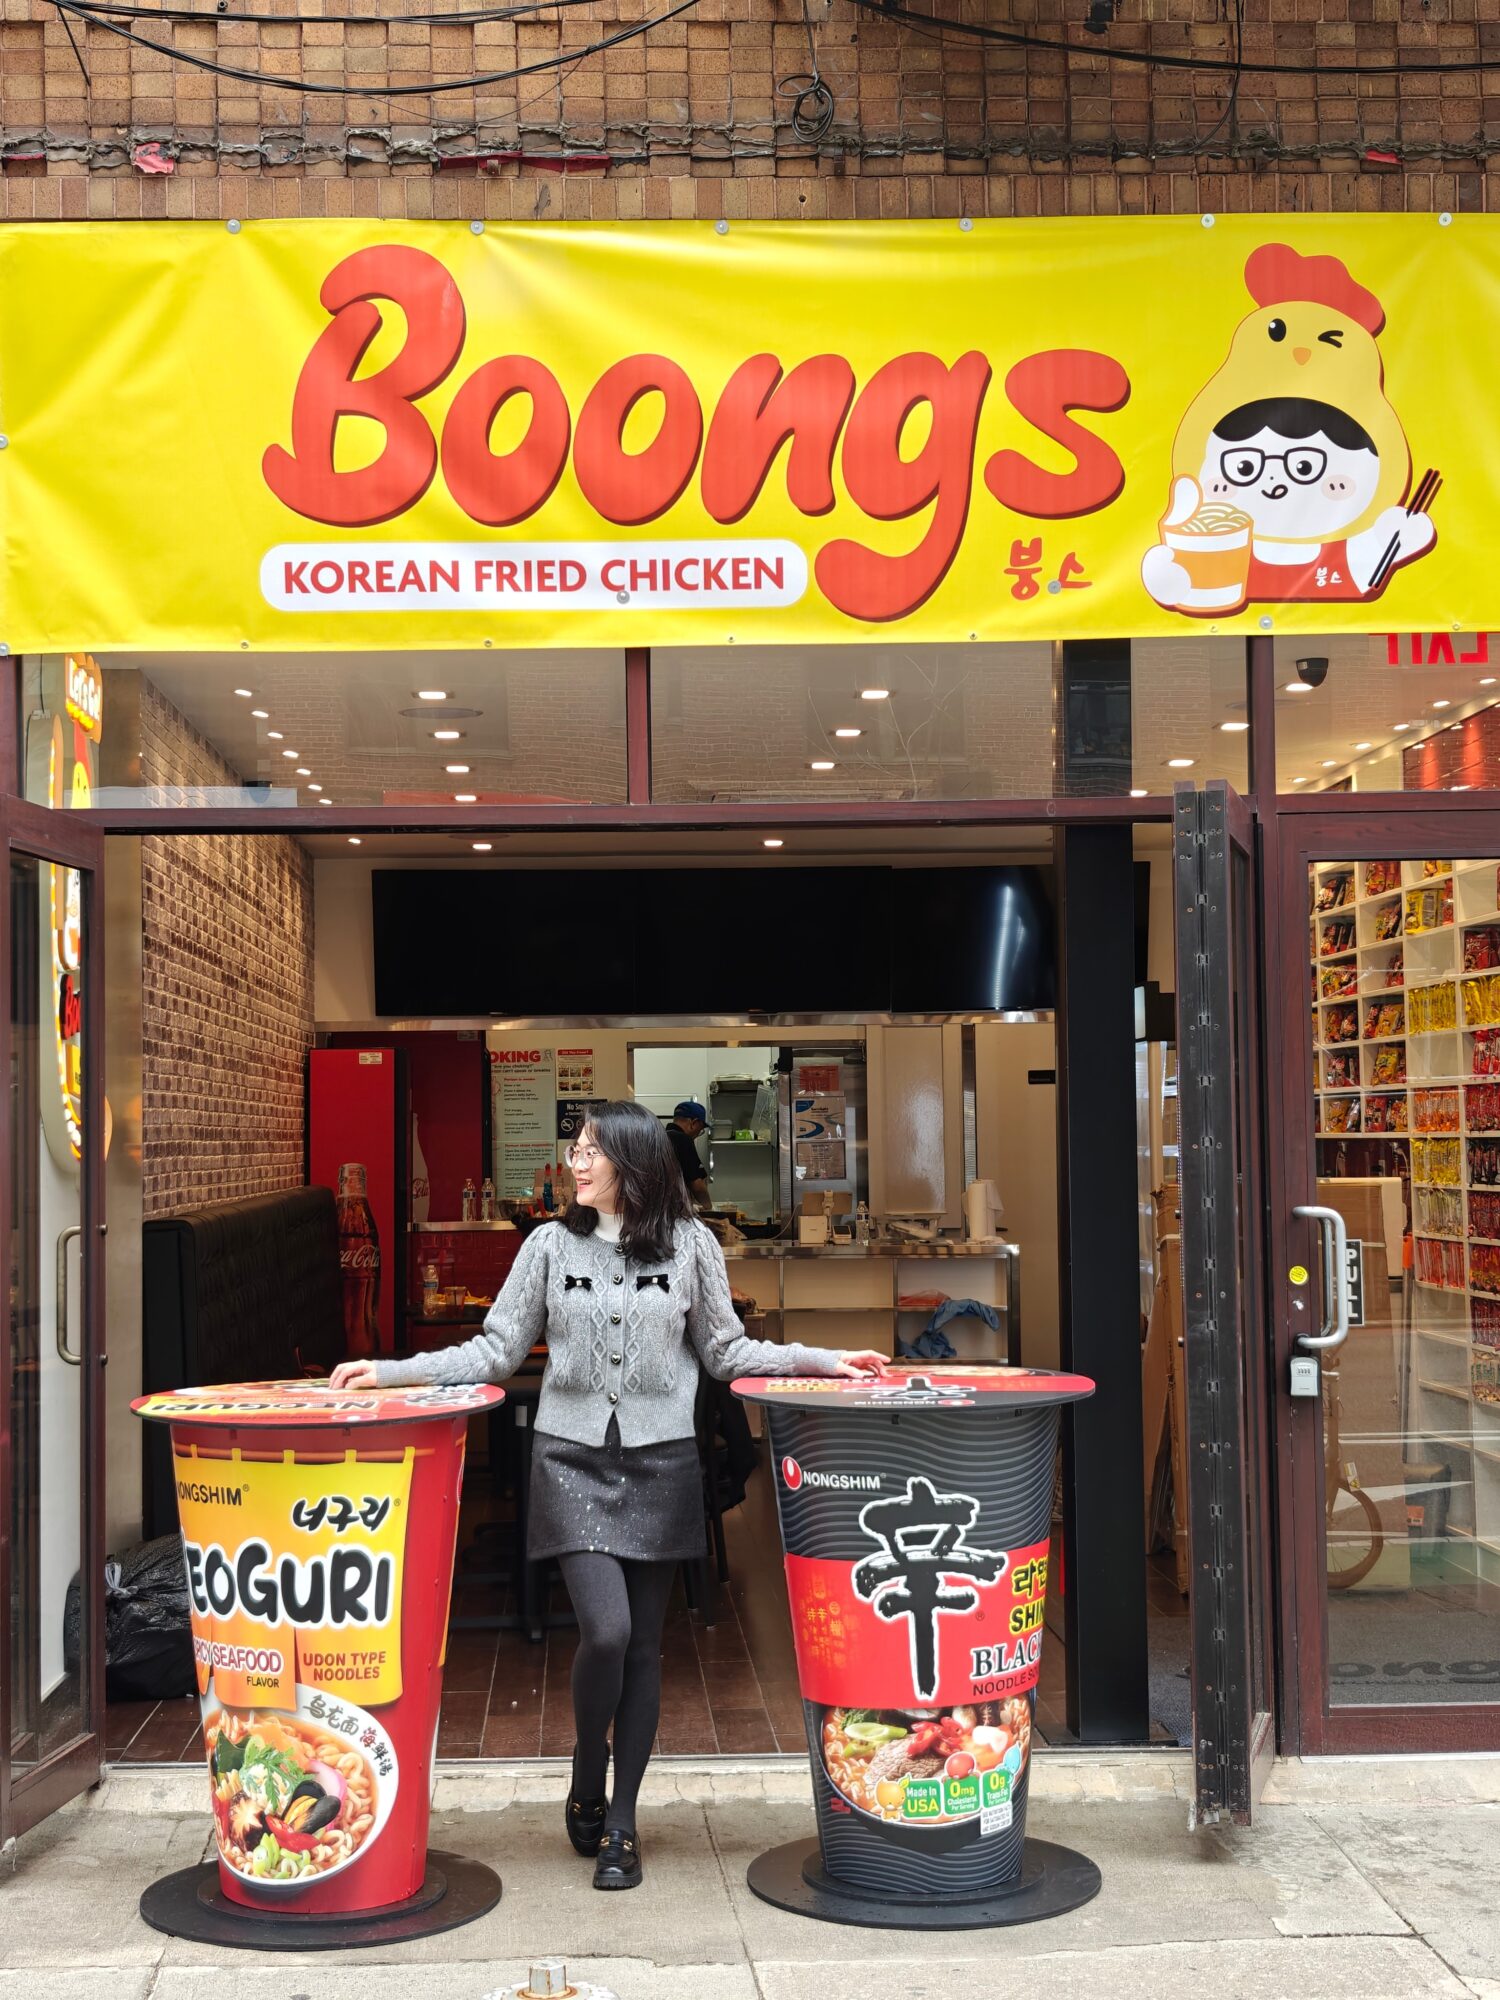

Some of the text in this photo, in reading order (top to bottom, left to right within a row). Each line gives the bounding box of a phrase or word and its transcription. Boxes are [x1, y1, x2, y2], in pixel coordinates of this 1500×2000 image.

[262, 244, 1131, 622] Boongs
[284, 557, 785, 594] KOREAN FRIED CHICKEN
[490, 1050, 541, 1064] OKING
[1345, 1248, 1358, 1318] PULL
[803, 1471, 881, 1490] NONGSHIM
[177, 1481, 242, 1506] ONGSHIM
[292, 1496, 390, 1532] 너구리
[186, 1542, 391, 1624] EOGURI
[212, 1644, 283, 1673] SEAFOOD
[303, 1650, 386, 1666] UDON TYPE
[247, 1676, 280, 1688] FLAVOR
[313, 1666, 380, 1682] NOODLES
[973, 1671, 1026, 1696] NOODLE
[906, 1786, 937, 1798] Made In
[989, 1772, 1005, 1791] 0g
[907, 1798, 939, 1813] USA
